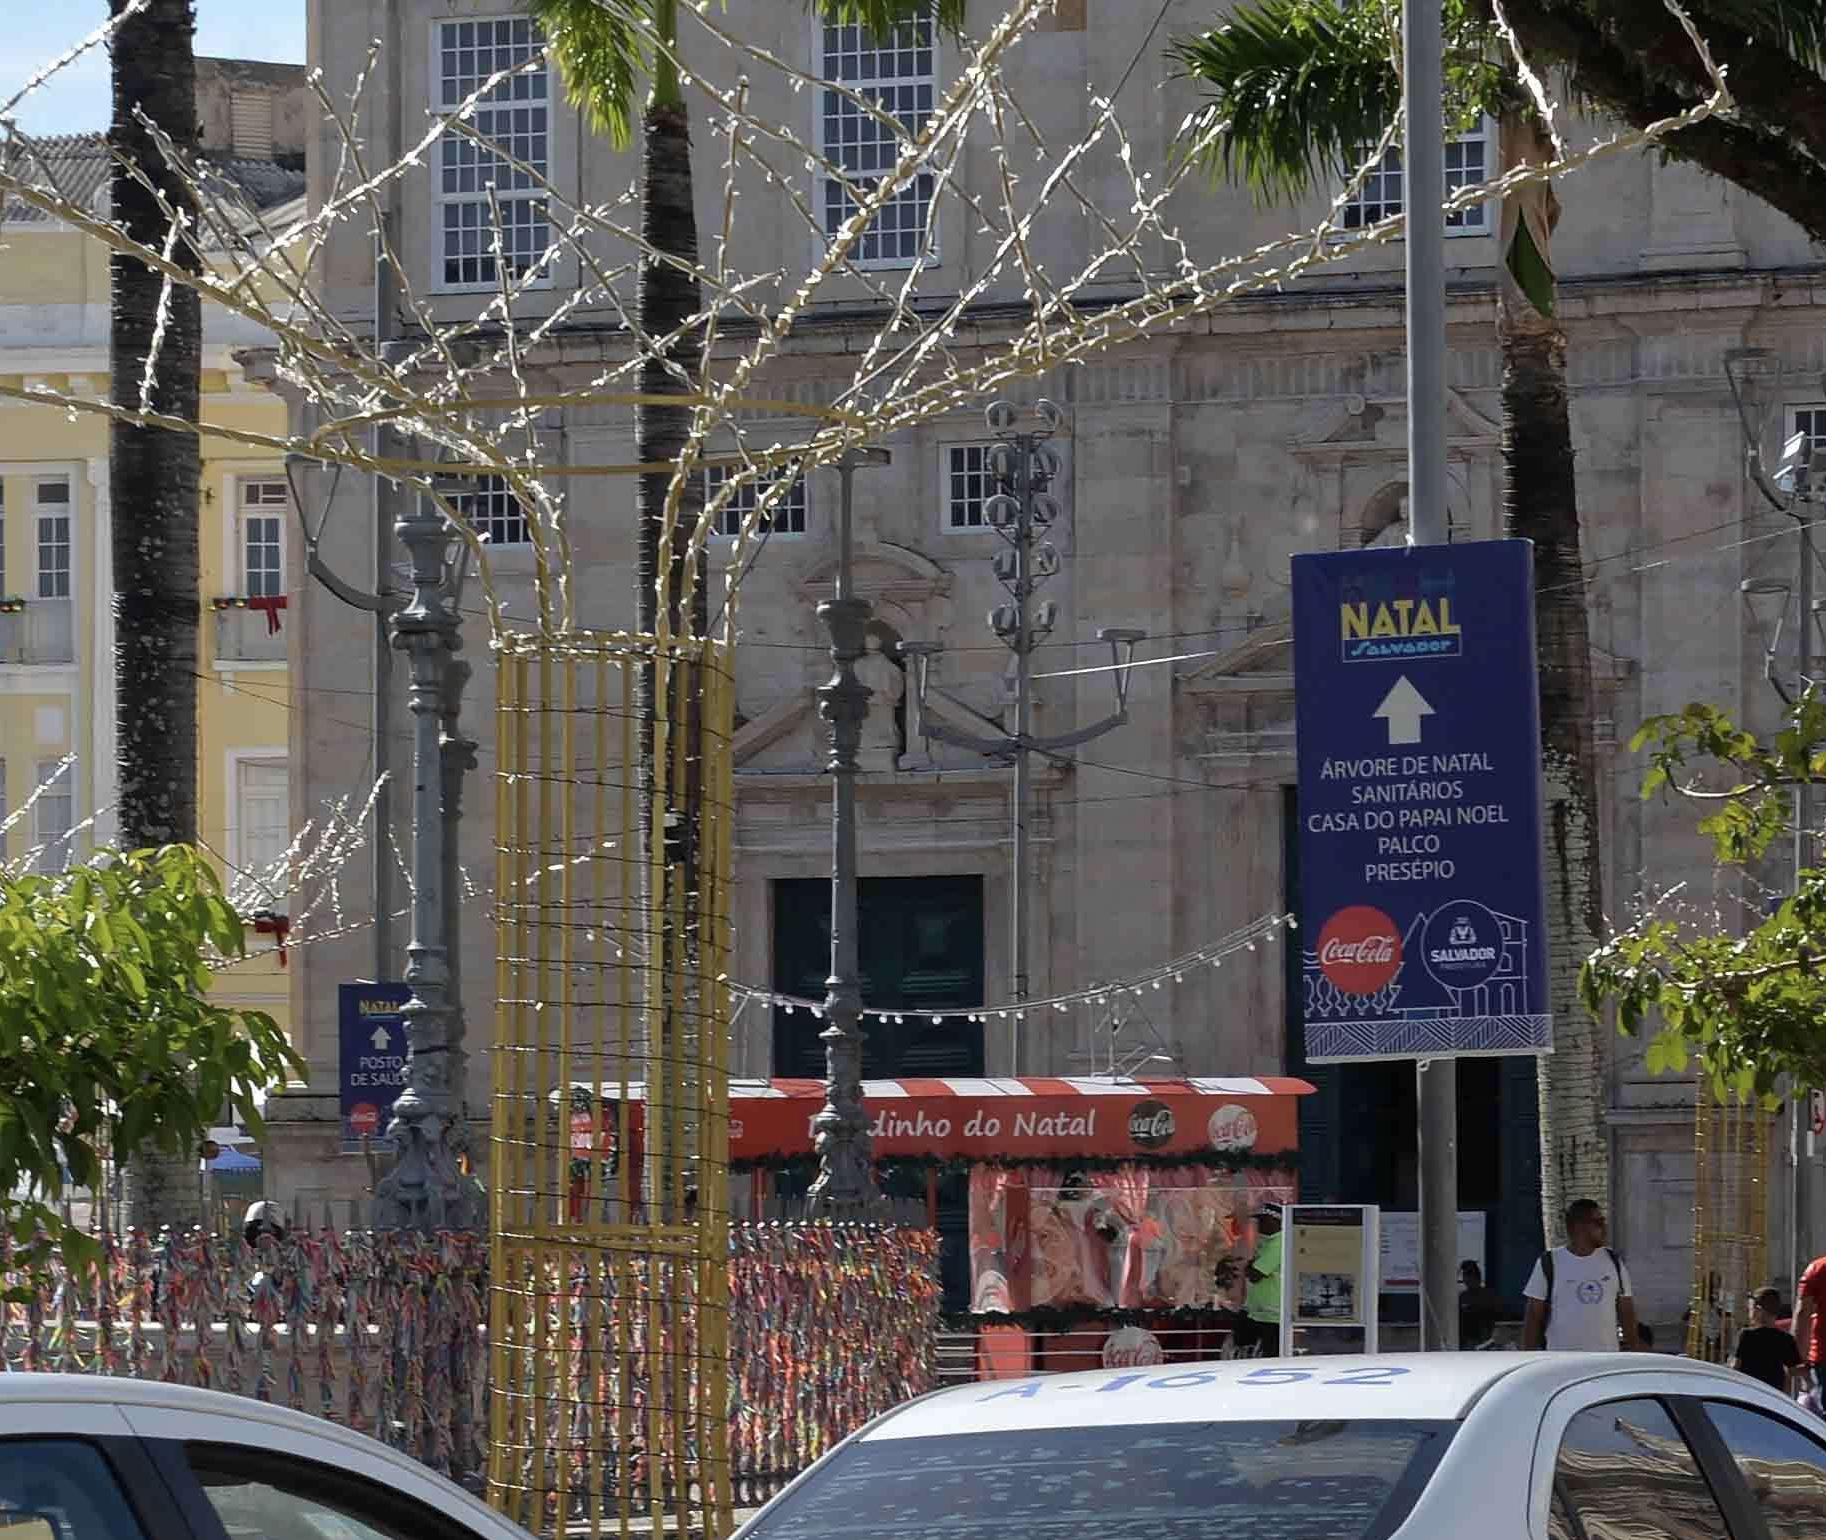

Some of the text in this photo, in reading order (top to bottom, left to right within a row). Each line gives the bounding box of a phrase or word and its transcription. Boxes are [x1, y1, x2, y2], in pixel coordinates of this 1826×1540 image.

[1340, 597, 1462, 640] NATAL
[1320, 752, 1495, 780] ÁRVORE DE NATAL
[1351, 780, 1464, 804] SANITÁRIOS
[1308, 805, 1510, 832] CASA DO PAPAI NOEL
[1377, 834, 1440, 855] PALCO
[1365, 858, 1455, 882] PRESÉPIO
[1430, 947, 1496, 963] SALVADOR
[359, 1056, 404, 1070] POSTO
[350, 1073, 368, 1086] DE
[963, 1109, 1001, 1138] do
[1013, 1108, 1096, 1138] Natal
[978, 1366, 1411, 1402] A-1652
